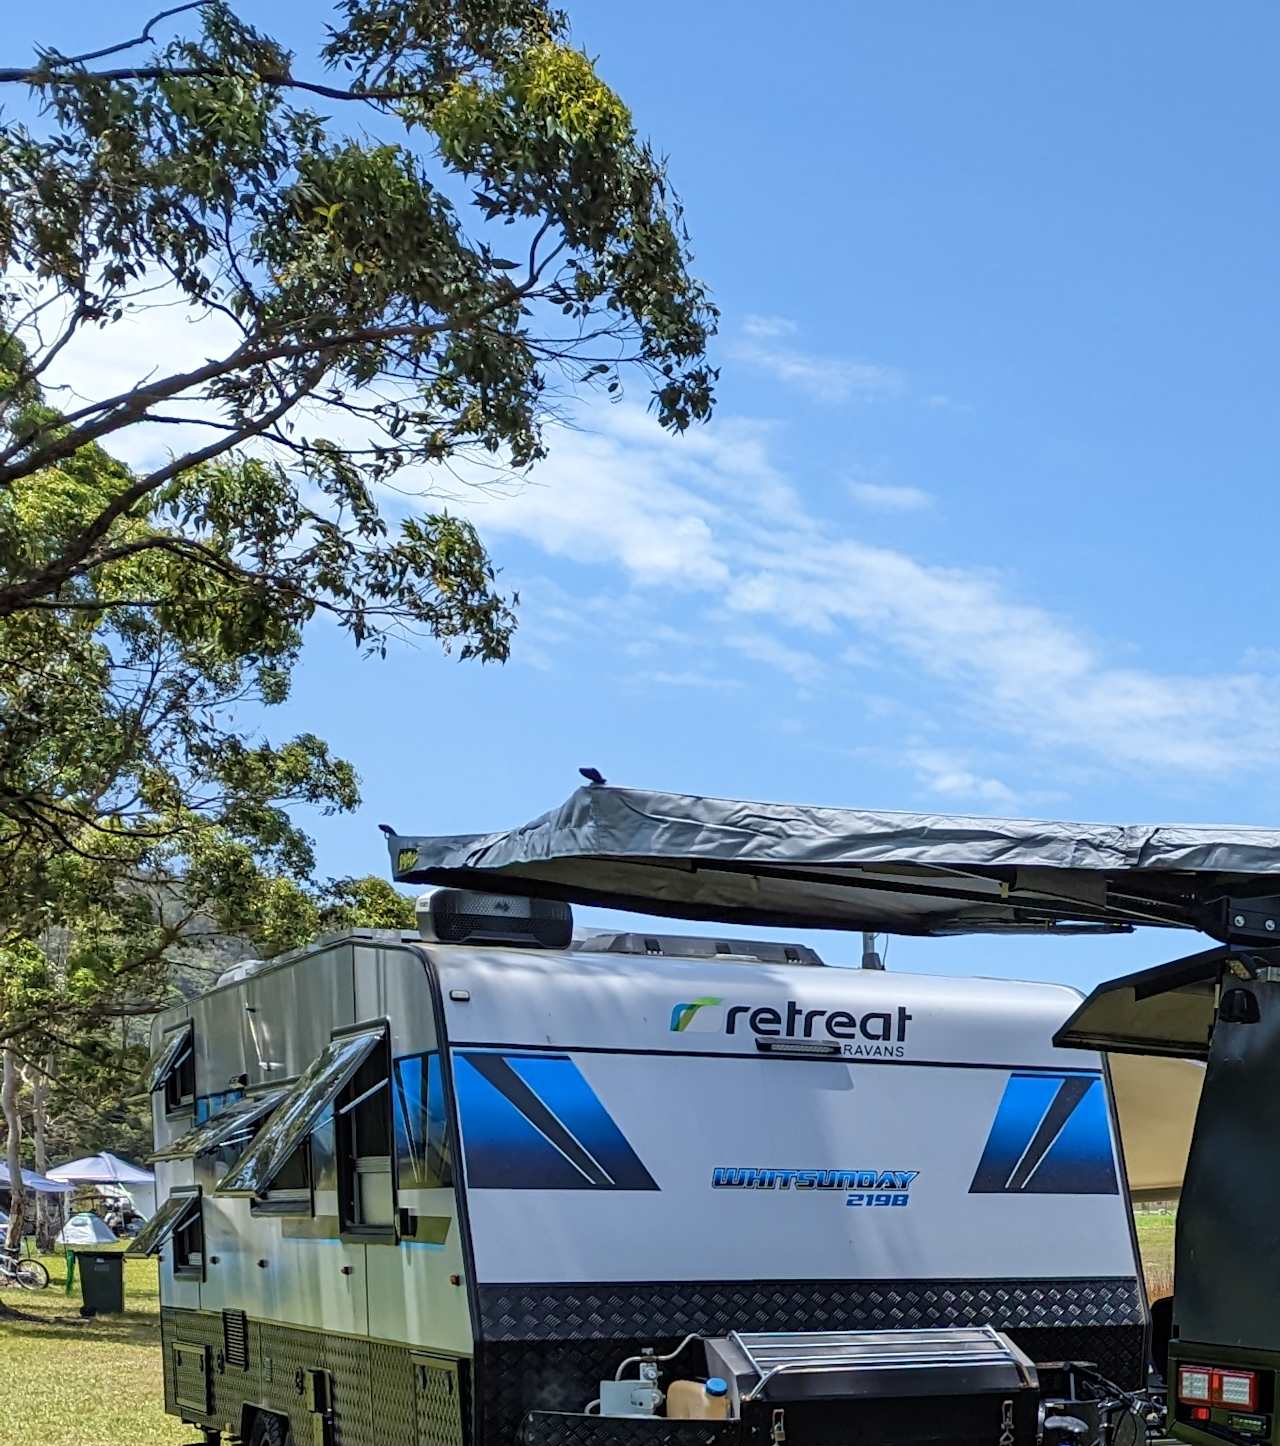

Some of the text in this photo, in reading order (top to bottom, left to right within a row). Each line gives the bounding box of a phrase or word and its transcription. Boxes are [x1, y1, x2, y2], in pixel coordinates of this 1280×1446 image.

[725, 1001, 912, 1042] retreat
[839, 1043, 905, 1057] RAVANS
[712, 1167, 920, 1191] WHITSUNDAY
